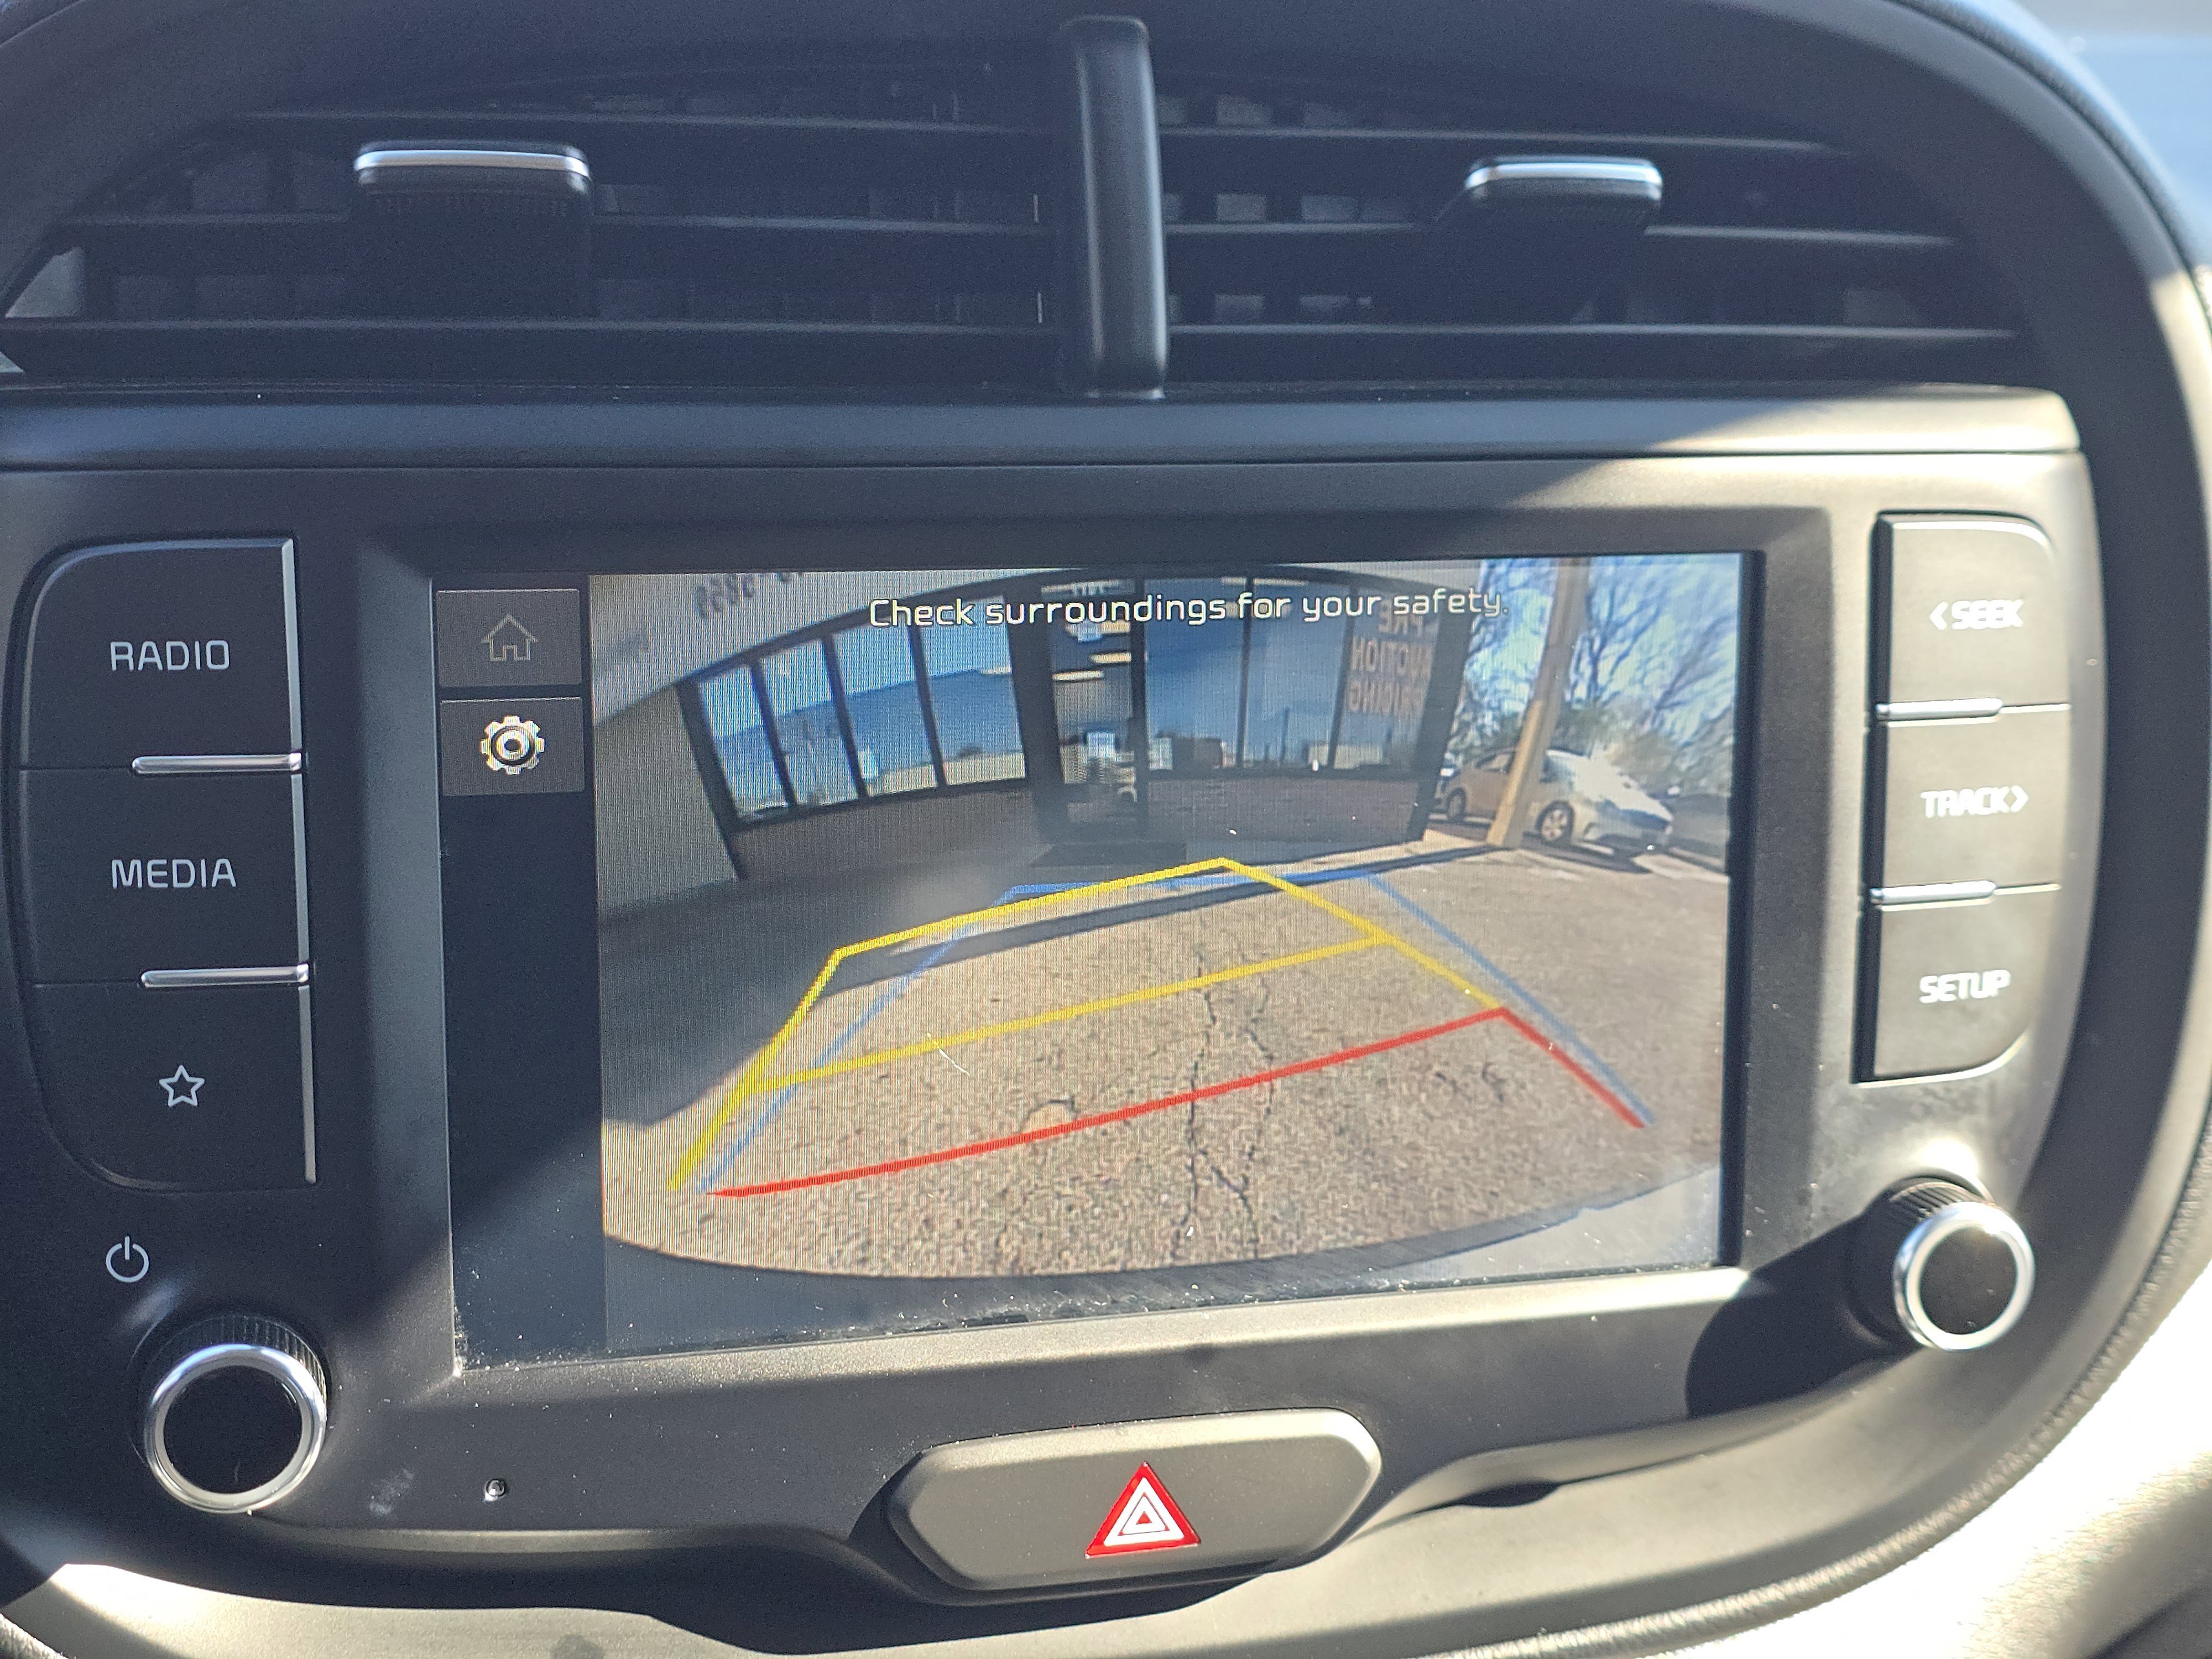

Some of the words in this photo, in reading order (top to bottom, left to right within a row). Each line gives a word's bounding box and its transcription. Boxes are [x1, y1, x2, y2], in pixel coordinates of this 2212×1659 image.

[870, 597, 973, 627] Check
[987, 593, 1226, 626] surroundings
[1238, 592, 1291, 619] for
[1303, 596, 1381, 622] your
[1393, 587, 1508, 617] safety.
[1950, 599, 2025, 631] SEEK
[109, 640, 231, 671] RADIO
[1920, 788, 2011, 818] TRACK
[111, 858, 237, 889] MEDIA
[1919, 969, 2011, 1004] SETUP
